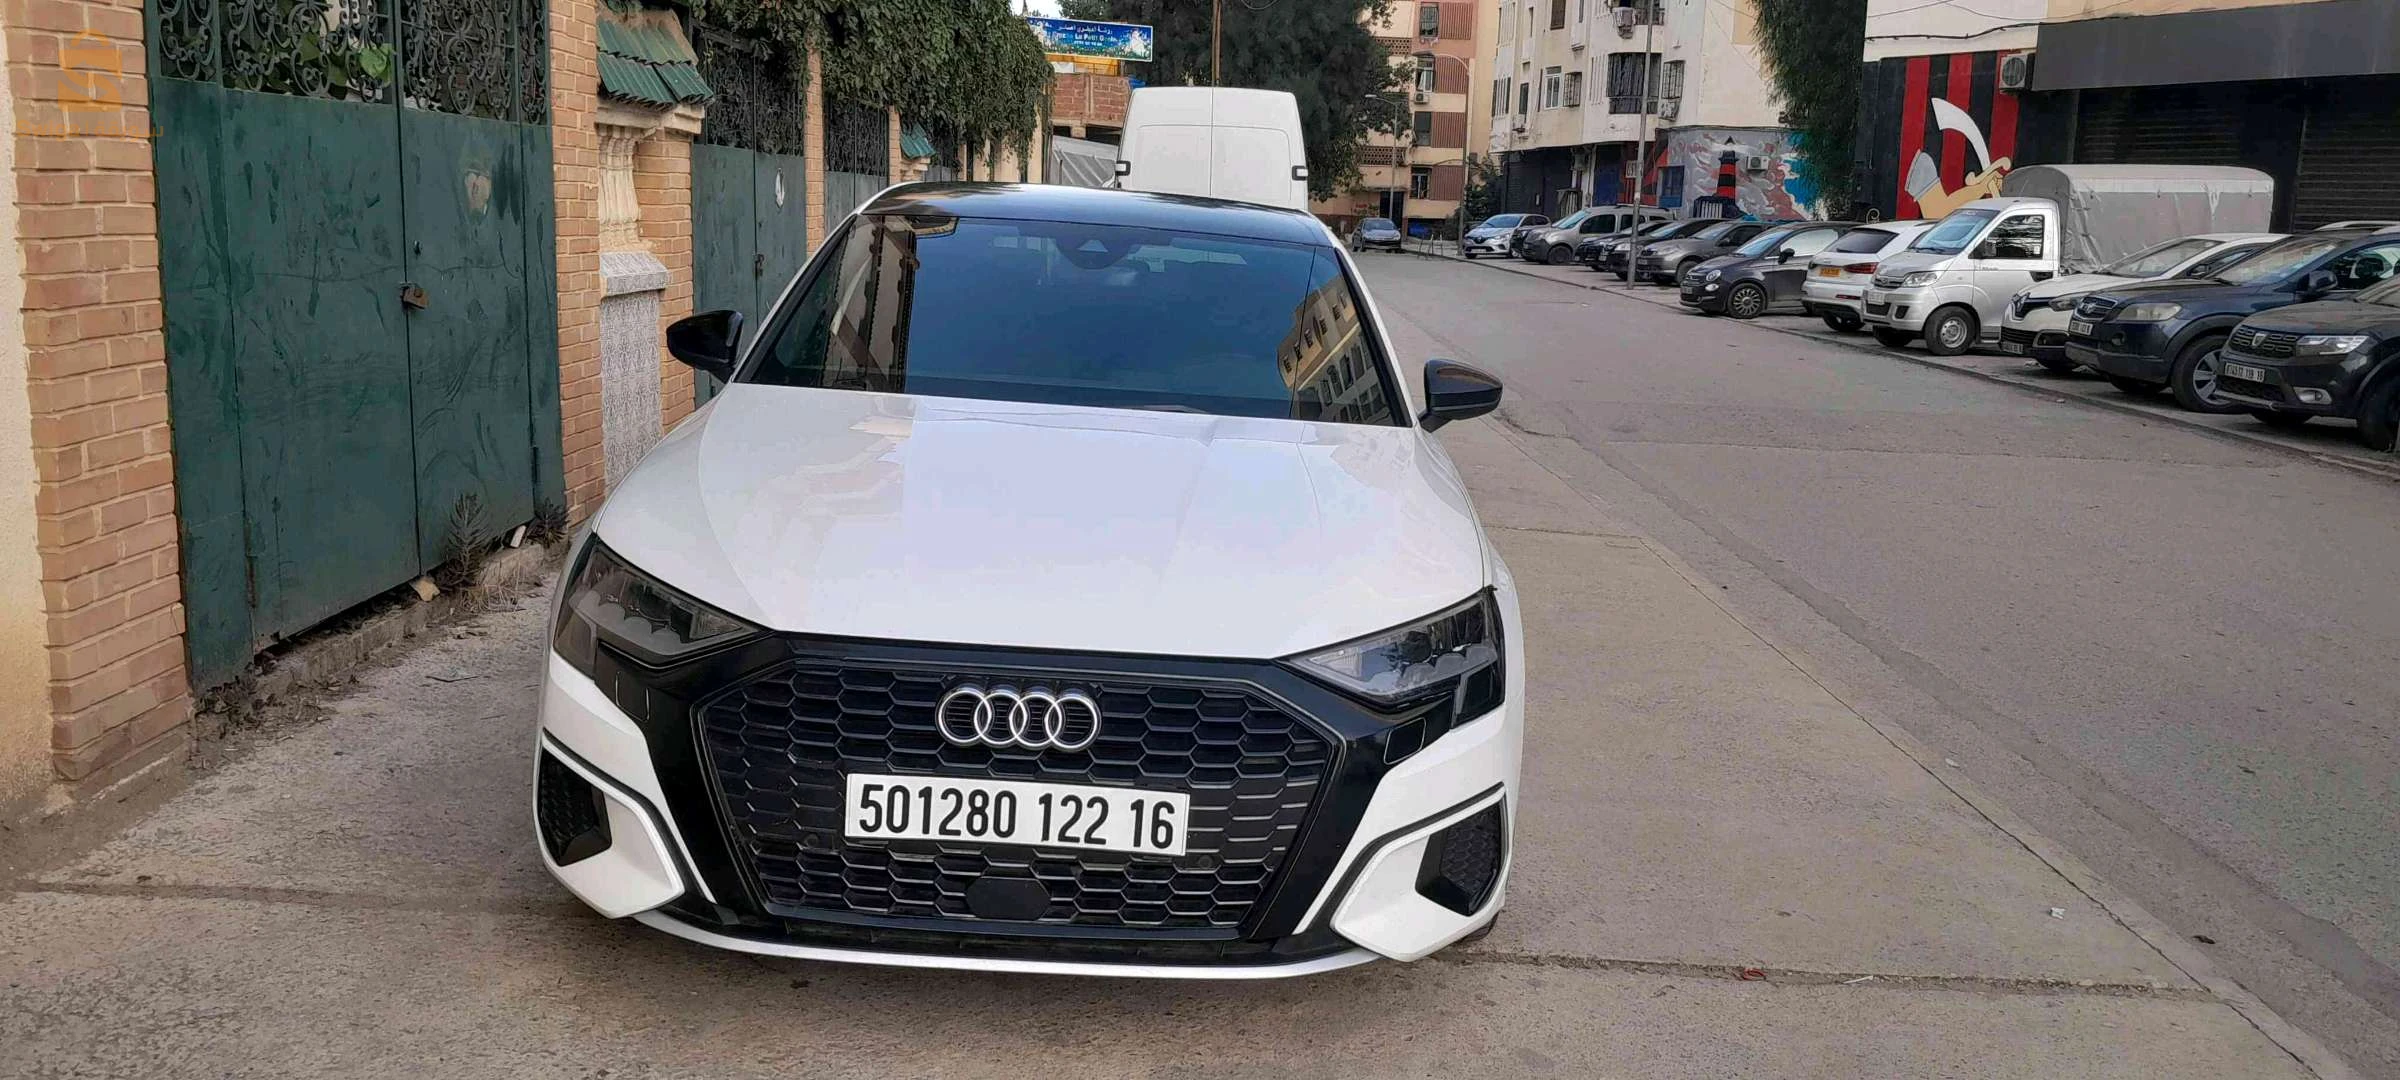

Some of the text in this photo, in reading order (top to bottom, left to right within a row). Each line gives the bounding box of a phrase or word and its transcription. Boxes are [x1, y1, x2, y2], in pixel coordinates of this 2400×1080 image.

[859, 783, 1175, 850] 501280 122 16
